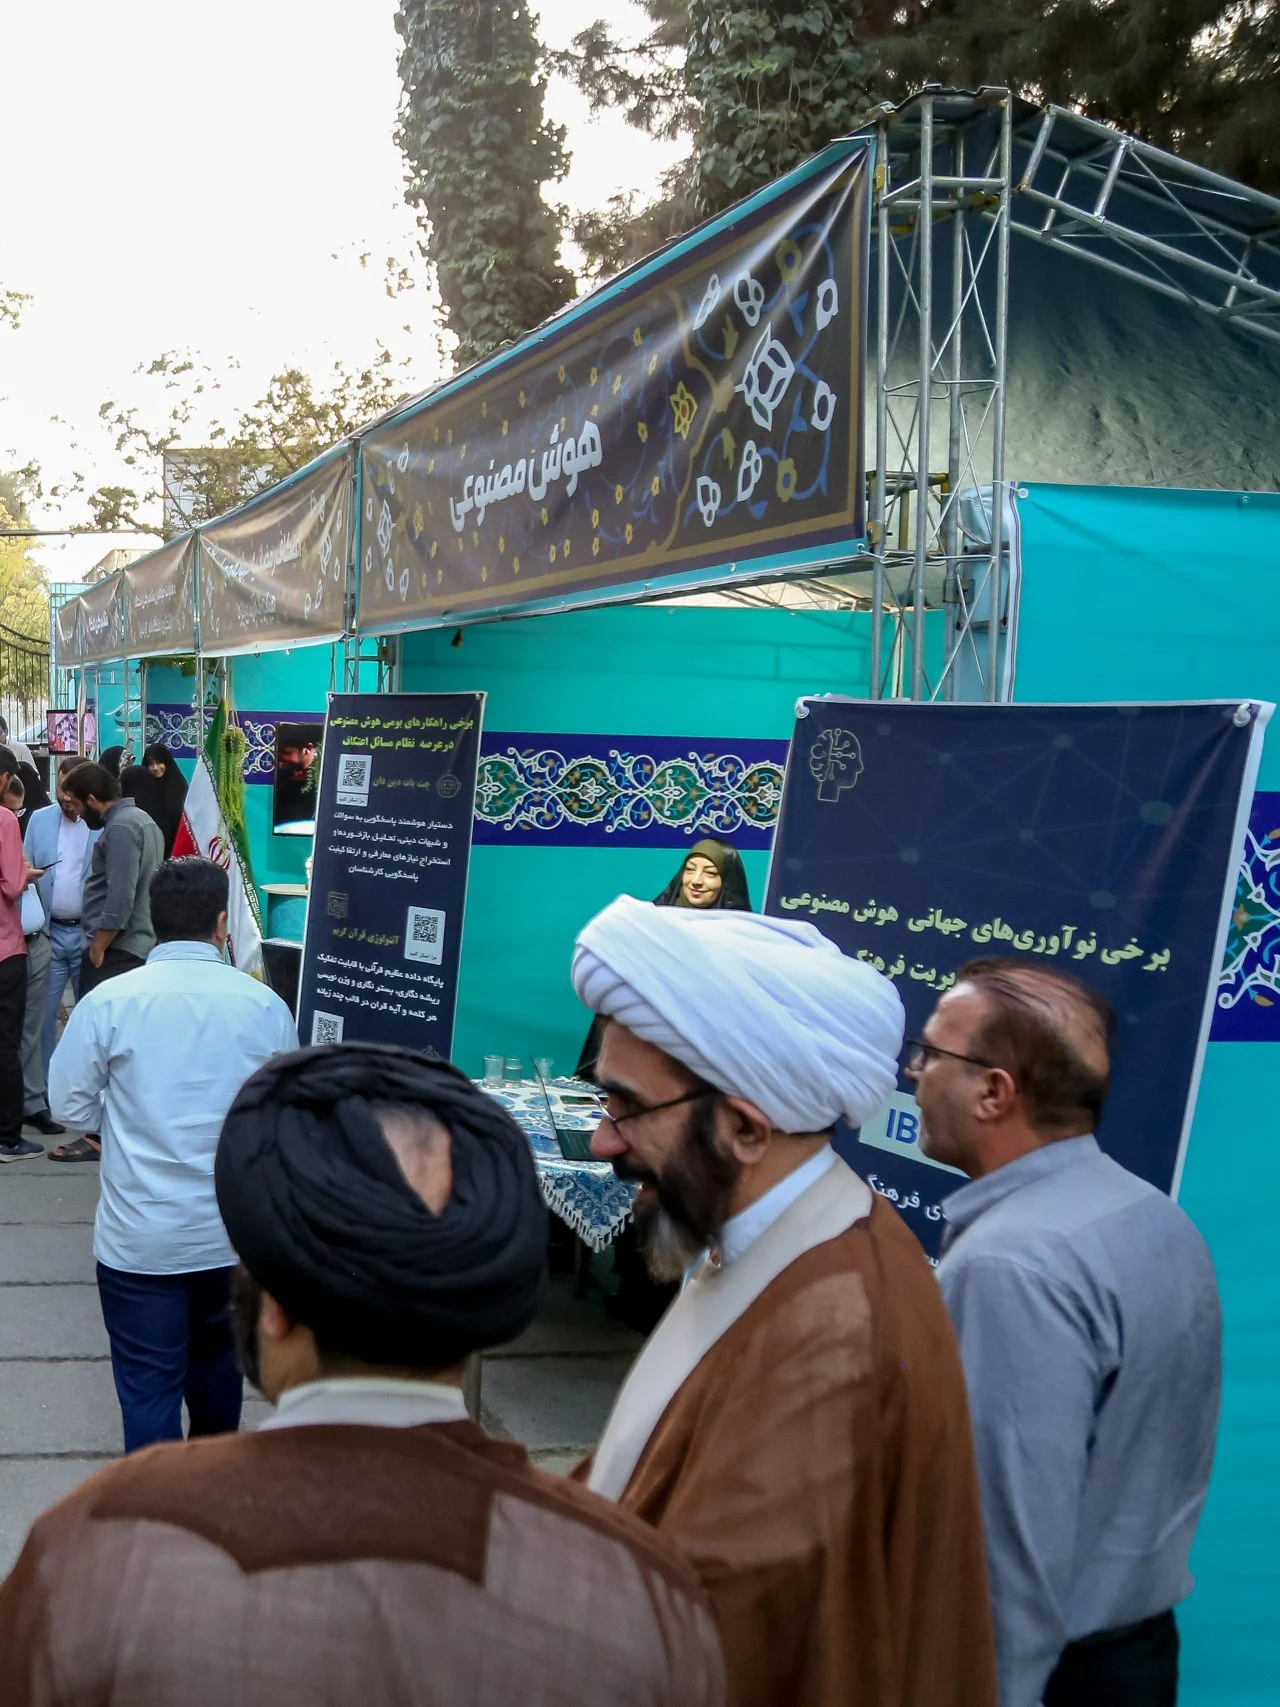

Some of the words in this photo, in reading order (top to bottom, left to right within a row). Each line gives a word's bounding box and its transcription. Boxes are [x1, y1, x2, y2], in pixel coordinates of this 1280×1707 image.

[528, 420, 603, 501] هوش
[449, 458, 528, 532] مصنوعی
[330, 716, 359, 728] مصنوعی
[360, 716, 381, 729] هوش
[383, 719, 403, 729] بومی
[449, 717, 474, 730] برخی
[342, 735, 369, 746] اعتکاف
[370, 735, 394, 750] مسائل
[395, 737, 416, 751] نظام
[419, 740, 443, 752] عرصه
[442, 740, 455, 752] در
[334, 811, 355, 821] سوالات
[355, 815, 363, 823] به
[363, 814, 397, 828] پاسخگویی
[398, 818, 427, 829] هوشمند
[427, 820, 454, 830] دستیار
[371, 832, 396, 843] تحلیل
[418, 838, 442, 848] شبهات
[328, 844, 346, 854] کیفیت
[442, 841, 449, 849] و
[362, 850, 368, 858] و
[368, 849, 392, 861] معارفی
[392, 853, 419, 864] نیازهای
[419, 856, 451, 868] استخراج
[348, 864, 384, 877] کارشناسان
[780, 892, 850, 914] مصنوعی
[853, 898, 899, 926] هوش
[908, 907, 968, 938] جهانی
[317, 953, 338, 964] تفکیک
[1100, 937, 1171, 972] برخی
[337, 958, 358, 969] قابلیت
[358, 961, 365, 972] با
[364, 961, 384, 975] قرآنی
[317, 973, 338, 982] نویسی
[384, 969, 404, 978] عظیم
[405, 972, 422, 981] داده
[909, 963, 958, 991] یریت
[337, 975, 351, 986] وزن
[350, 979, 356, 987] و
[356, 980, 375, 990] نگاری
[423, 975, 445, 989] پایگاه
[375, 984, 394, 996] بستر
[332, 991, 345, 1002] چند
[344, 994, 360, 1003] قالب
[419, 993, 441, 1005] ریشه
[360, 999, 369, 1007] در
[388, 1003, 402, 1014] آیه
[401, 1008, 407, 1017] و
[408, 1009, 426, 1019] کلمه
[885, 1107, 919, 1145] IB
